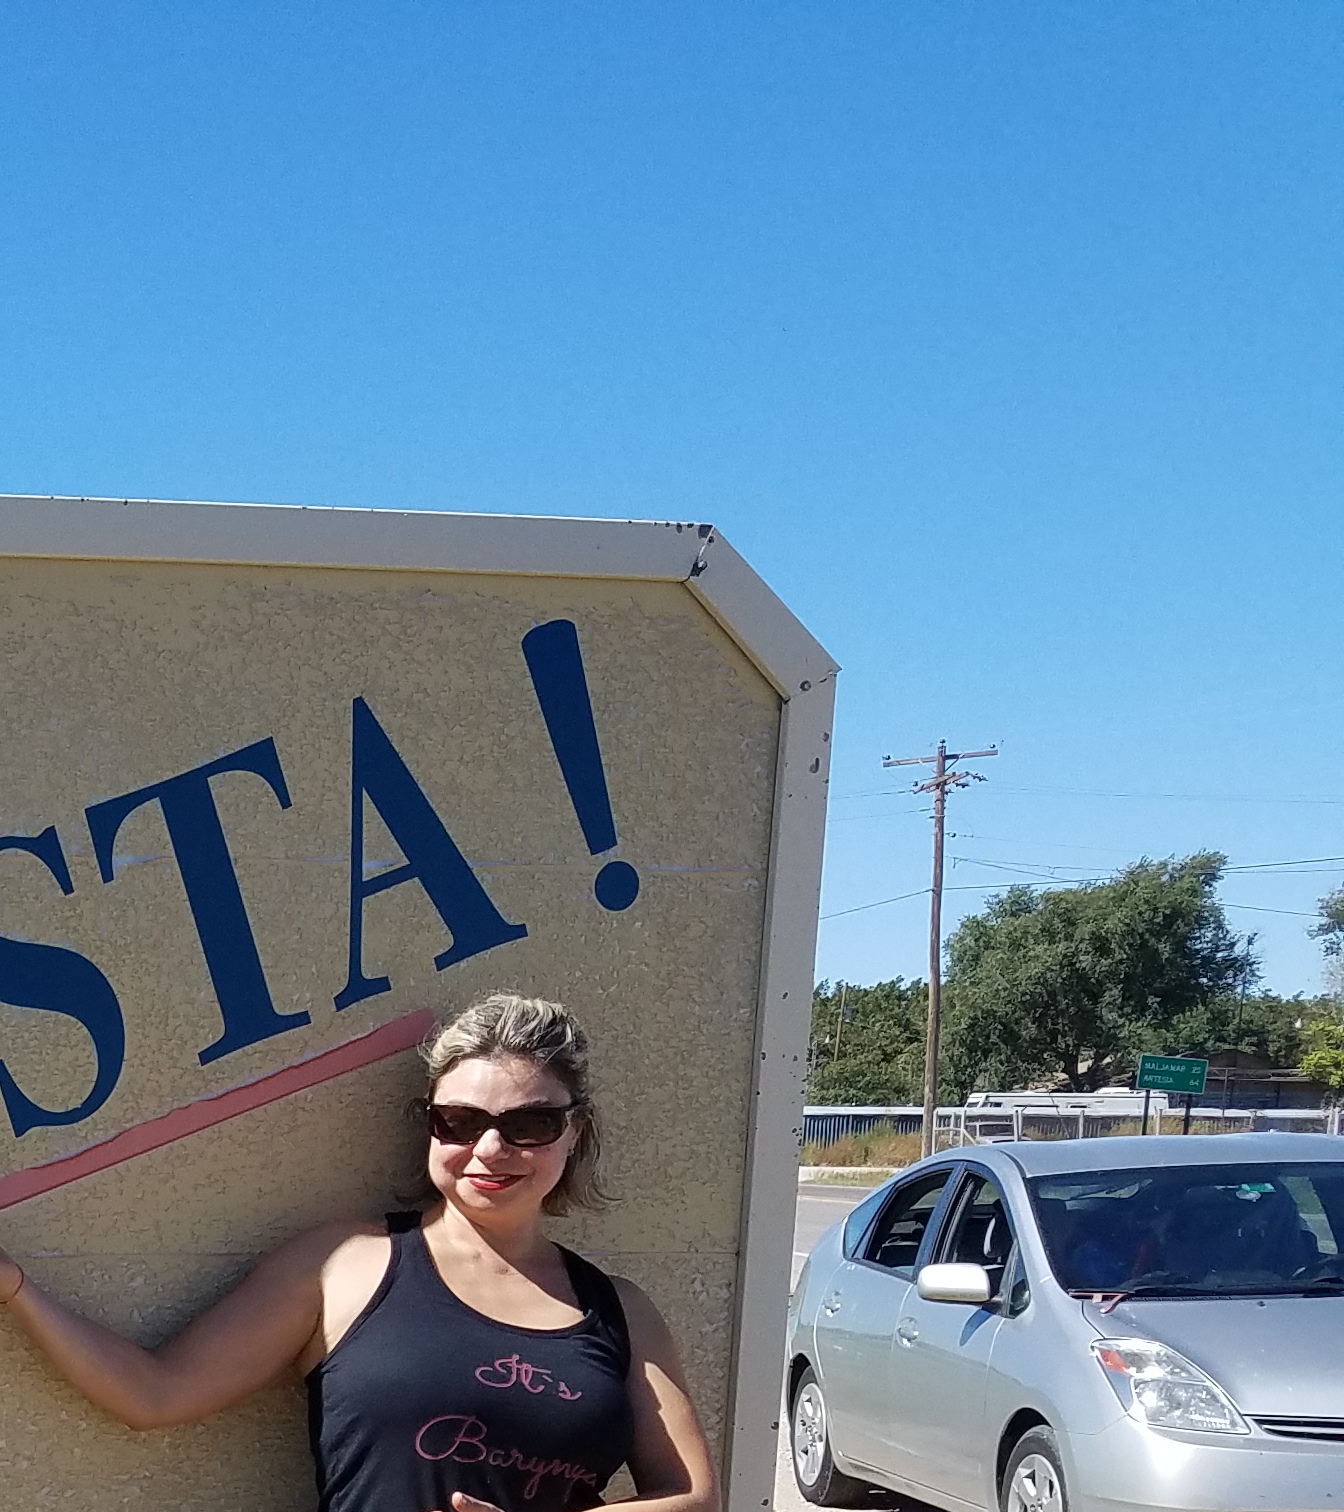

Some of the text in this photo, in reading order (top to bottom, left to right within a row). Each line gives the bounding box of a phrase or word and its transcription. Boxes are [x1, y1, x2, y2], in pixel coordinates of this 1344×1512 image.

[1143, 1074, 1200, 1087] ARTESIA 64
[474, 1353, 583, 1400] It's
